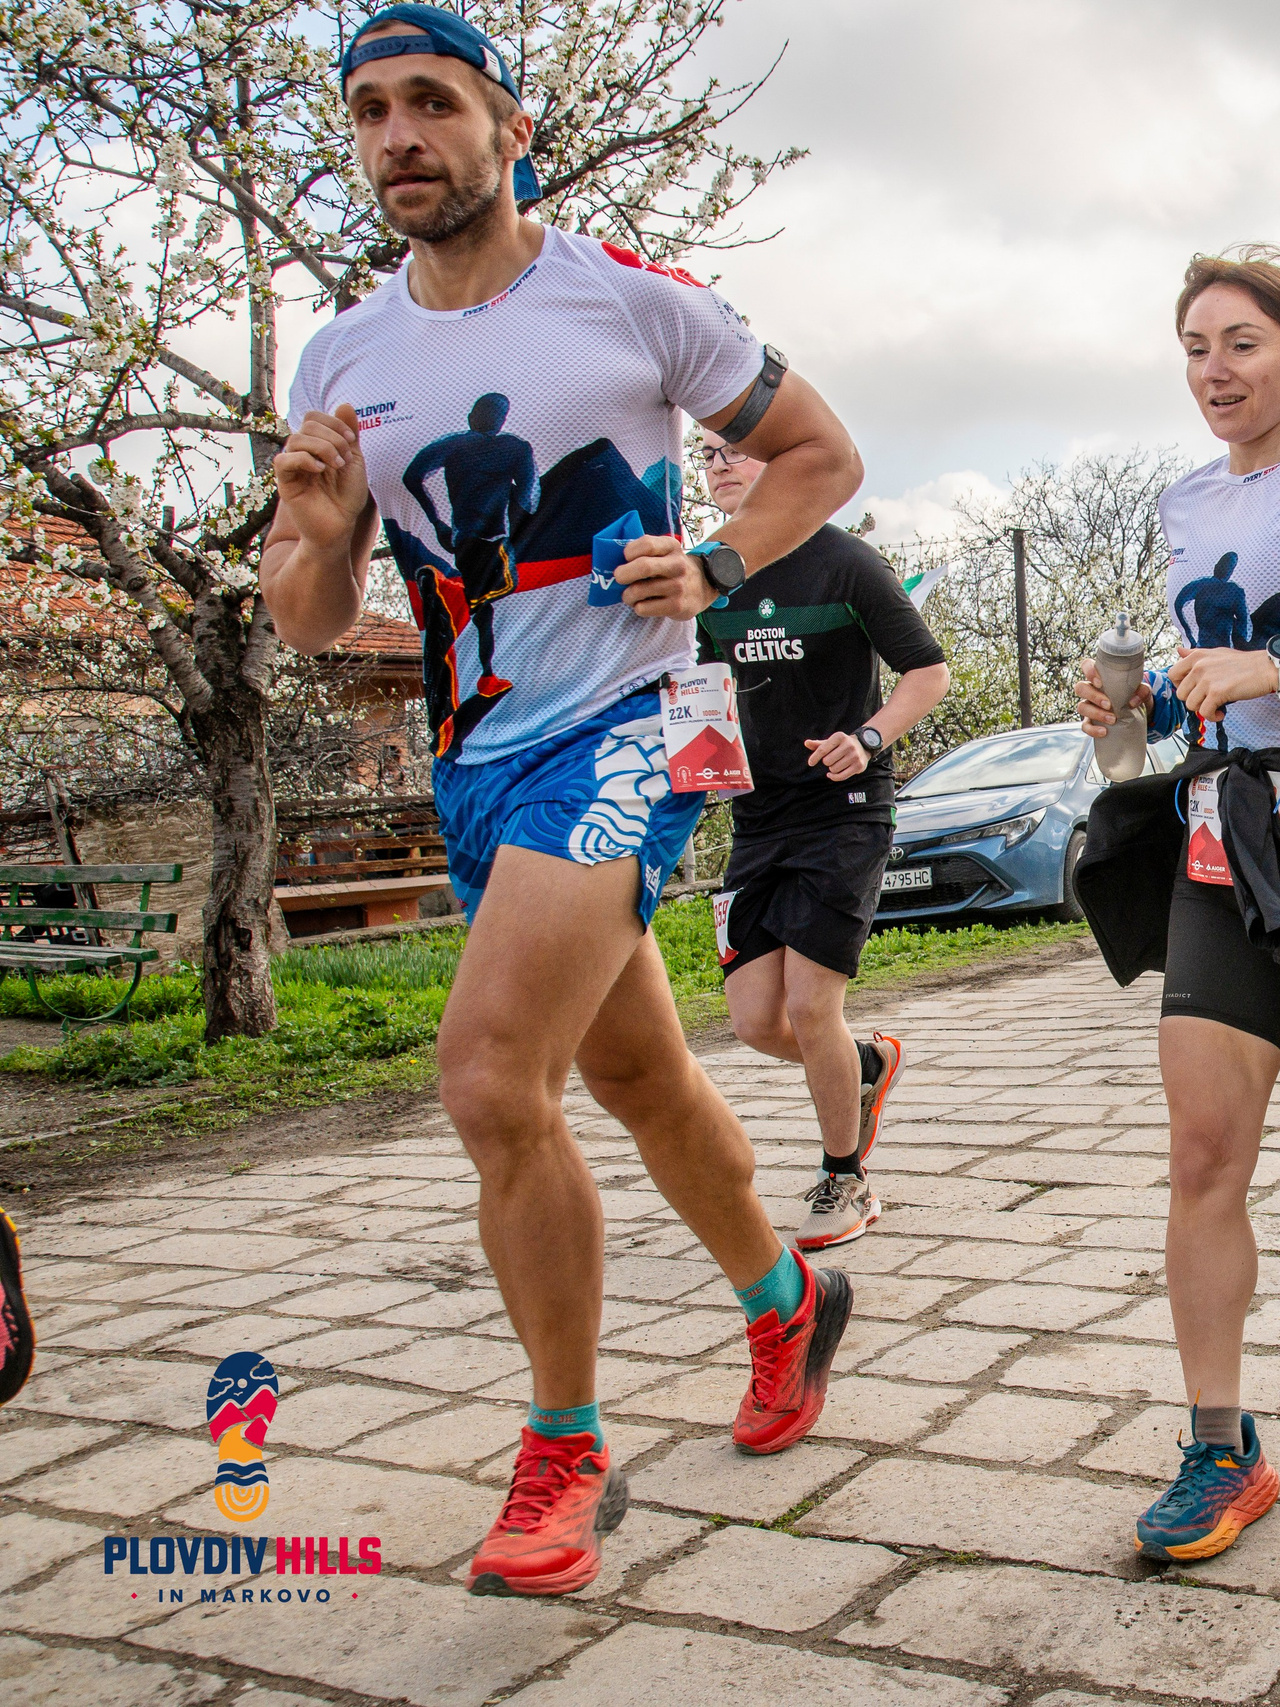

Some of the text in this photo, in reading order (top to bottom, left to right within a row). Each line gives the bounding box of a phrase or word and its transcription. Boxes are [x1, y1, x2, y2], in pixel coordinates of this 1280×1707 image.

[490, 291, 509, 307] STEP
[508, 263, 538, 294] MATTERS
[355, 400, 397, 418] PLOVDIV
[759, 598, 775, 609] CELTICS
[747, 627, 786, 640] BOSTON
[734, 639, 805, 663] CELTICS
[680, 677, 708, 689] PLOVDIV
[681, 686, 700, 697] HILLS
[668, 705, 693, 720] 22K
[854, 791, 867, 804] NBA
[884, 870, 930, 888] 4795 HC
